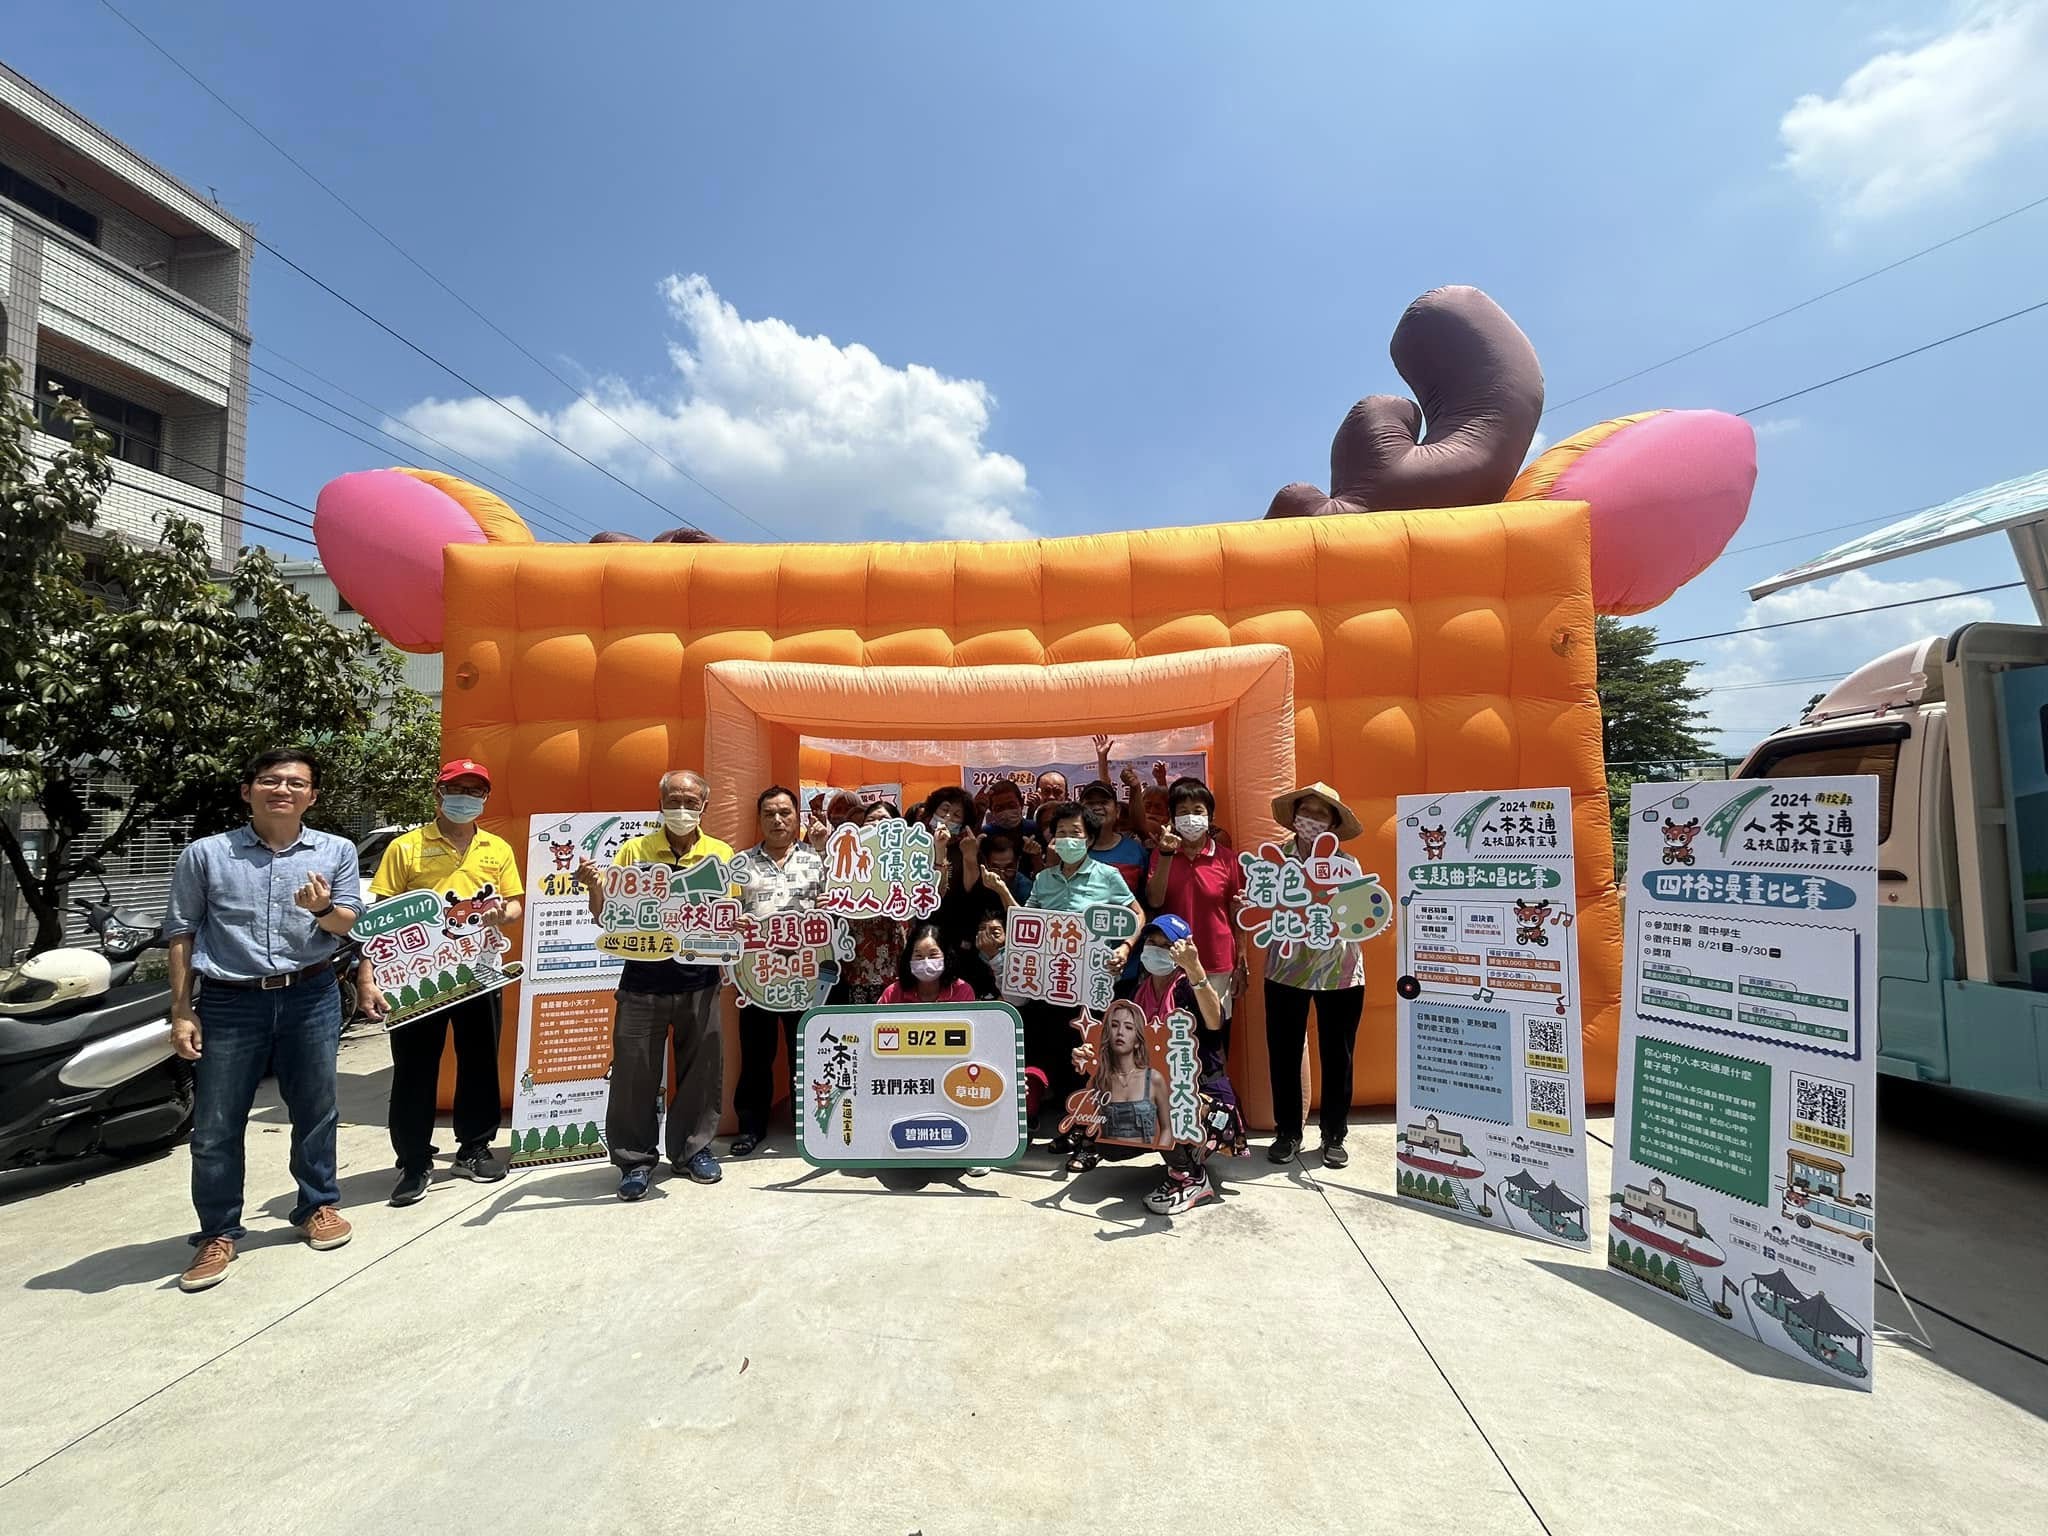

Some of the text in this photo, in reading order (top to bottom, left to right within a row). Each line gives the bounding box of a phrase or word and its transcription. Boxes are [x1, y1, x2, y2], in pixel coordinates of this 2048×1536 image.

[1500, 802, 1528, 812] 2024
[1771, 792, 1853, 807] 2024 南投縣
[620, 822, 641, 830] 2024
[880, 822, 931, 849] 行人
[1482, 814, 1557, 834] 人本交通
[1744, 810, 1854, 837] 人本交通
[1482, 836, 1558, 848] 及校園教育宣導
[1744, 838, 1854, 856] 及校園教育宣導
[879, 852, 931, 881] 優先
[1315, 862, 1352, 880] 國小
[1414, 865, 1549, 890] 主題曲歌唱比賽
[608, 870, 667, 900] 18場
[1253, 866, 1307, 903] 著色
[1656, 874, 1828, 911] 四格漫畫比賽
[829, 884, 936, 914] 以人為本
[602, 900, 738, 931] 社區與校園
[1093, 910, 1128, 936] 國中
[1276, 907, 1329, 942] 比賽
[370, 925, 426, 960] 全國
[744, 914, 828, 950] 主題曲
[1015, 920, 1082, 954] 四格
[1654, 921, 1742, 939] 參加對象 國中學生
[381, 930, 504, 985] 聯合成果展
[604, 936, 674, 952] 巡迴講座
[756, 951, 816, 983] 歌唱
[1011, 956, 1074, 1000] 漫畫
[1092, 952, 1110, 1008] 比賽
[766, 980, 808, 1006] 比賽
[908, 1030, 937, 1046] 9/2
[818, 1027, 852, 1090] 人本交通
[871, 1078, 936, 1096] 我們來到
[1170, 1016, 1199, 1138] 宣傳大使
[956, 1086, 992, 1100] 草屯鎮
[1061, 1088, 1108, 1134] Jocelyn
[905, 1128, 953, 1141] 碧洲社區
